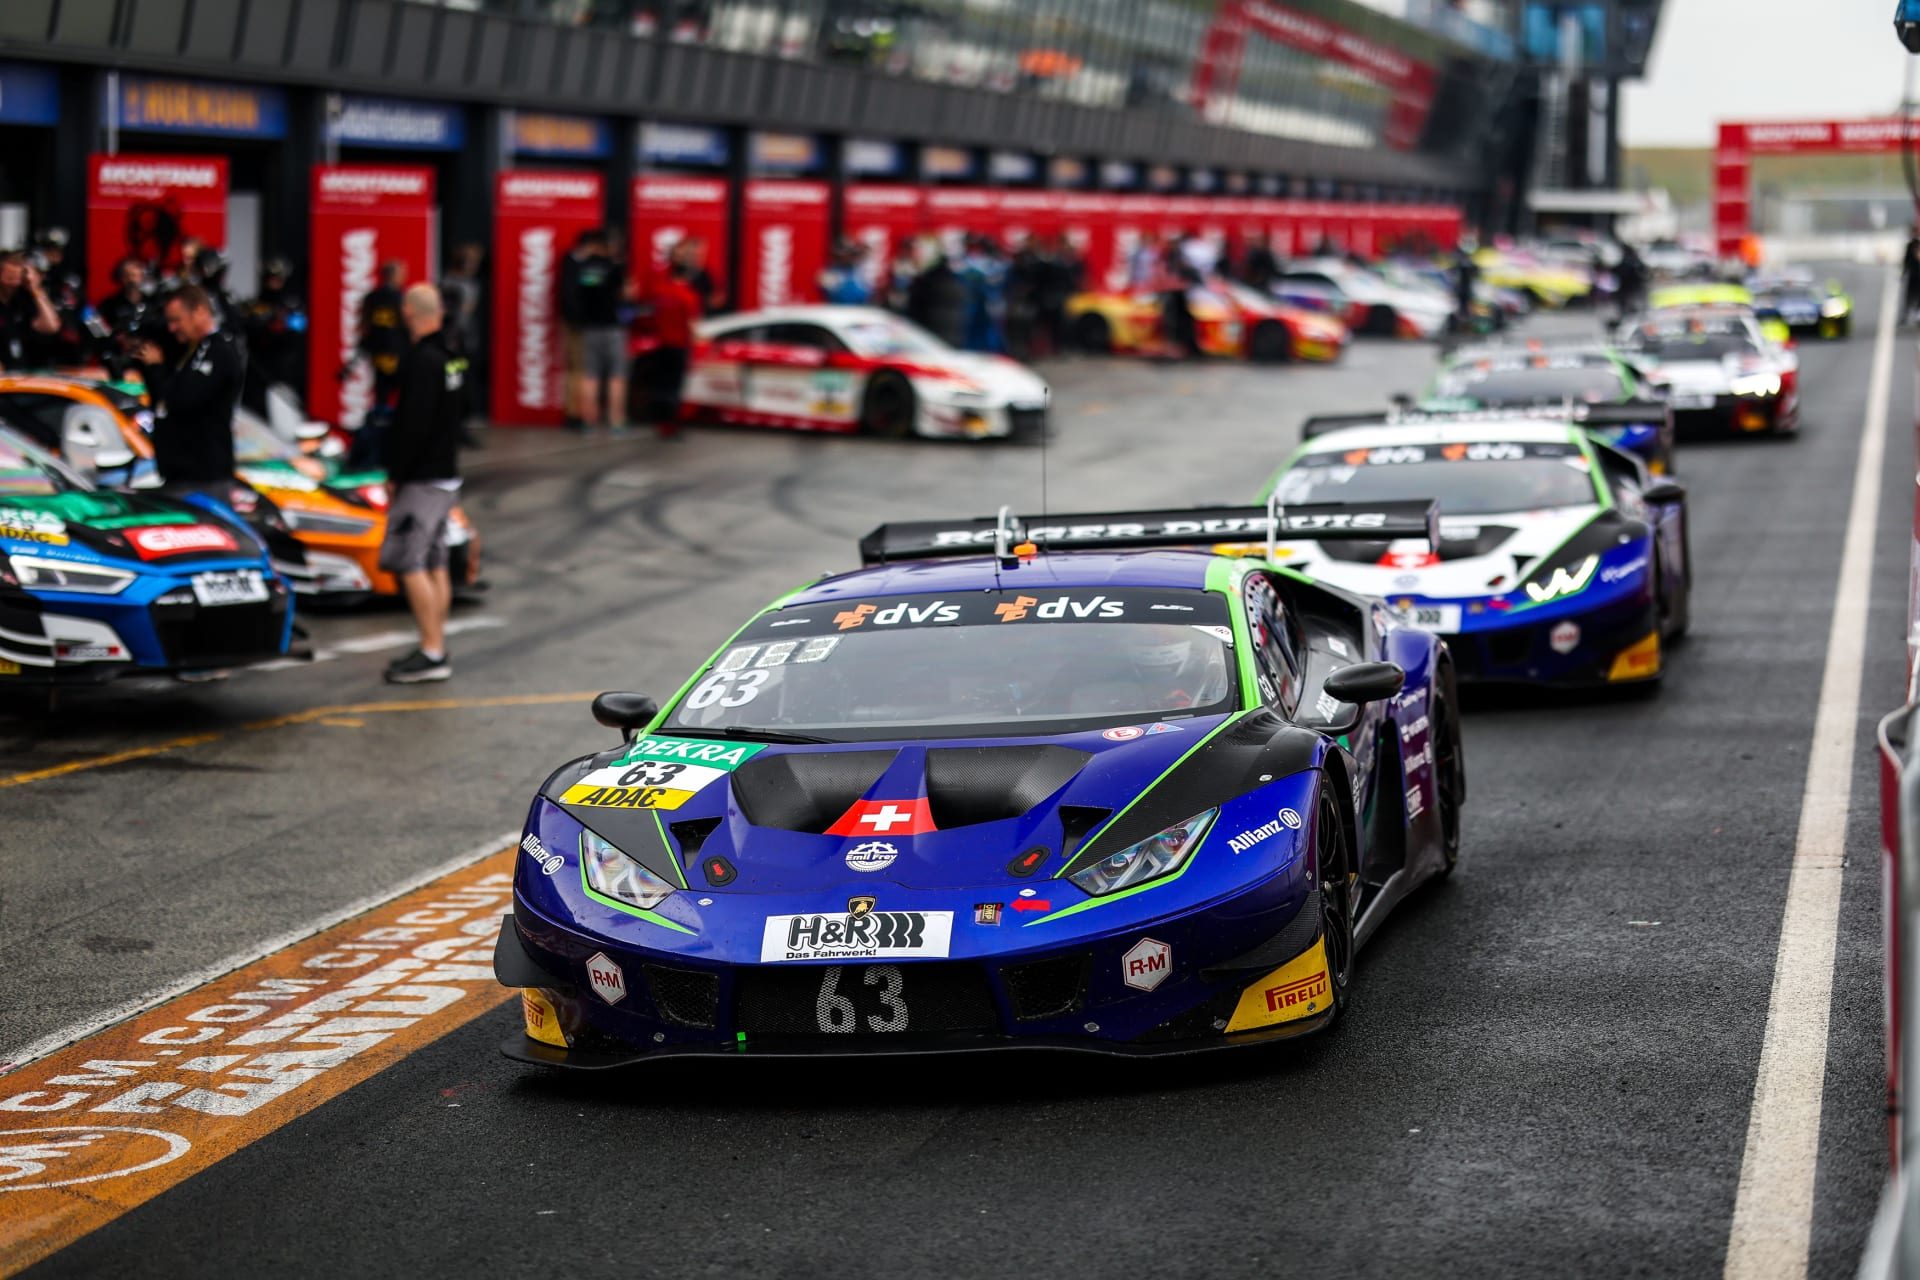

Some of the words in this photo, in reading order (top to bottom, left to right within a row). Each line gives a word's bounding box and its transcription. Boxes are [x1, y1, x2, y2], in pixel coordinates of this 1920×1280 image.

[873, 600, 962, 626] dvs
[1036, 595, 1125, 619] dvs
[685, 669, 770, 710] 63
[629, 739, 748, 765] DEKRA
[617, 761, 687, 787] 63
[578, 787, 667, 808] ADAC
[520, 832, 550, 864] Allianz
[1227, 820, 1285, 855] Allianz
[845, 853, 870, 861] Emil
[872, 851, 898, 862] Frey
[787, 914, 880, 950] H&R
[786, 950, 810, 959] Das
[813, 948, 877, 958] Fahrwerk!
[1129, 953, 1166, 977] R-M
[592, 968, 620, 989] R-M
[1264, 970, 1326, 1012] PIRELLI
[816, 965, 910, 1033] 63
